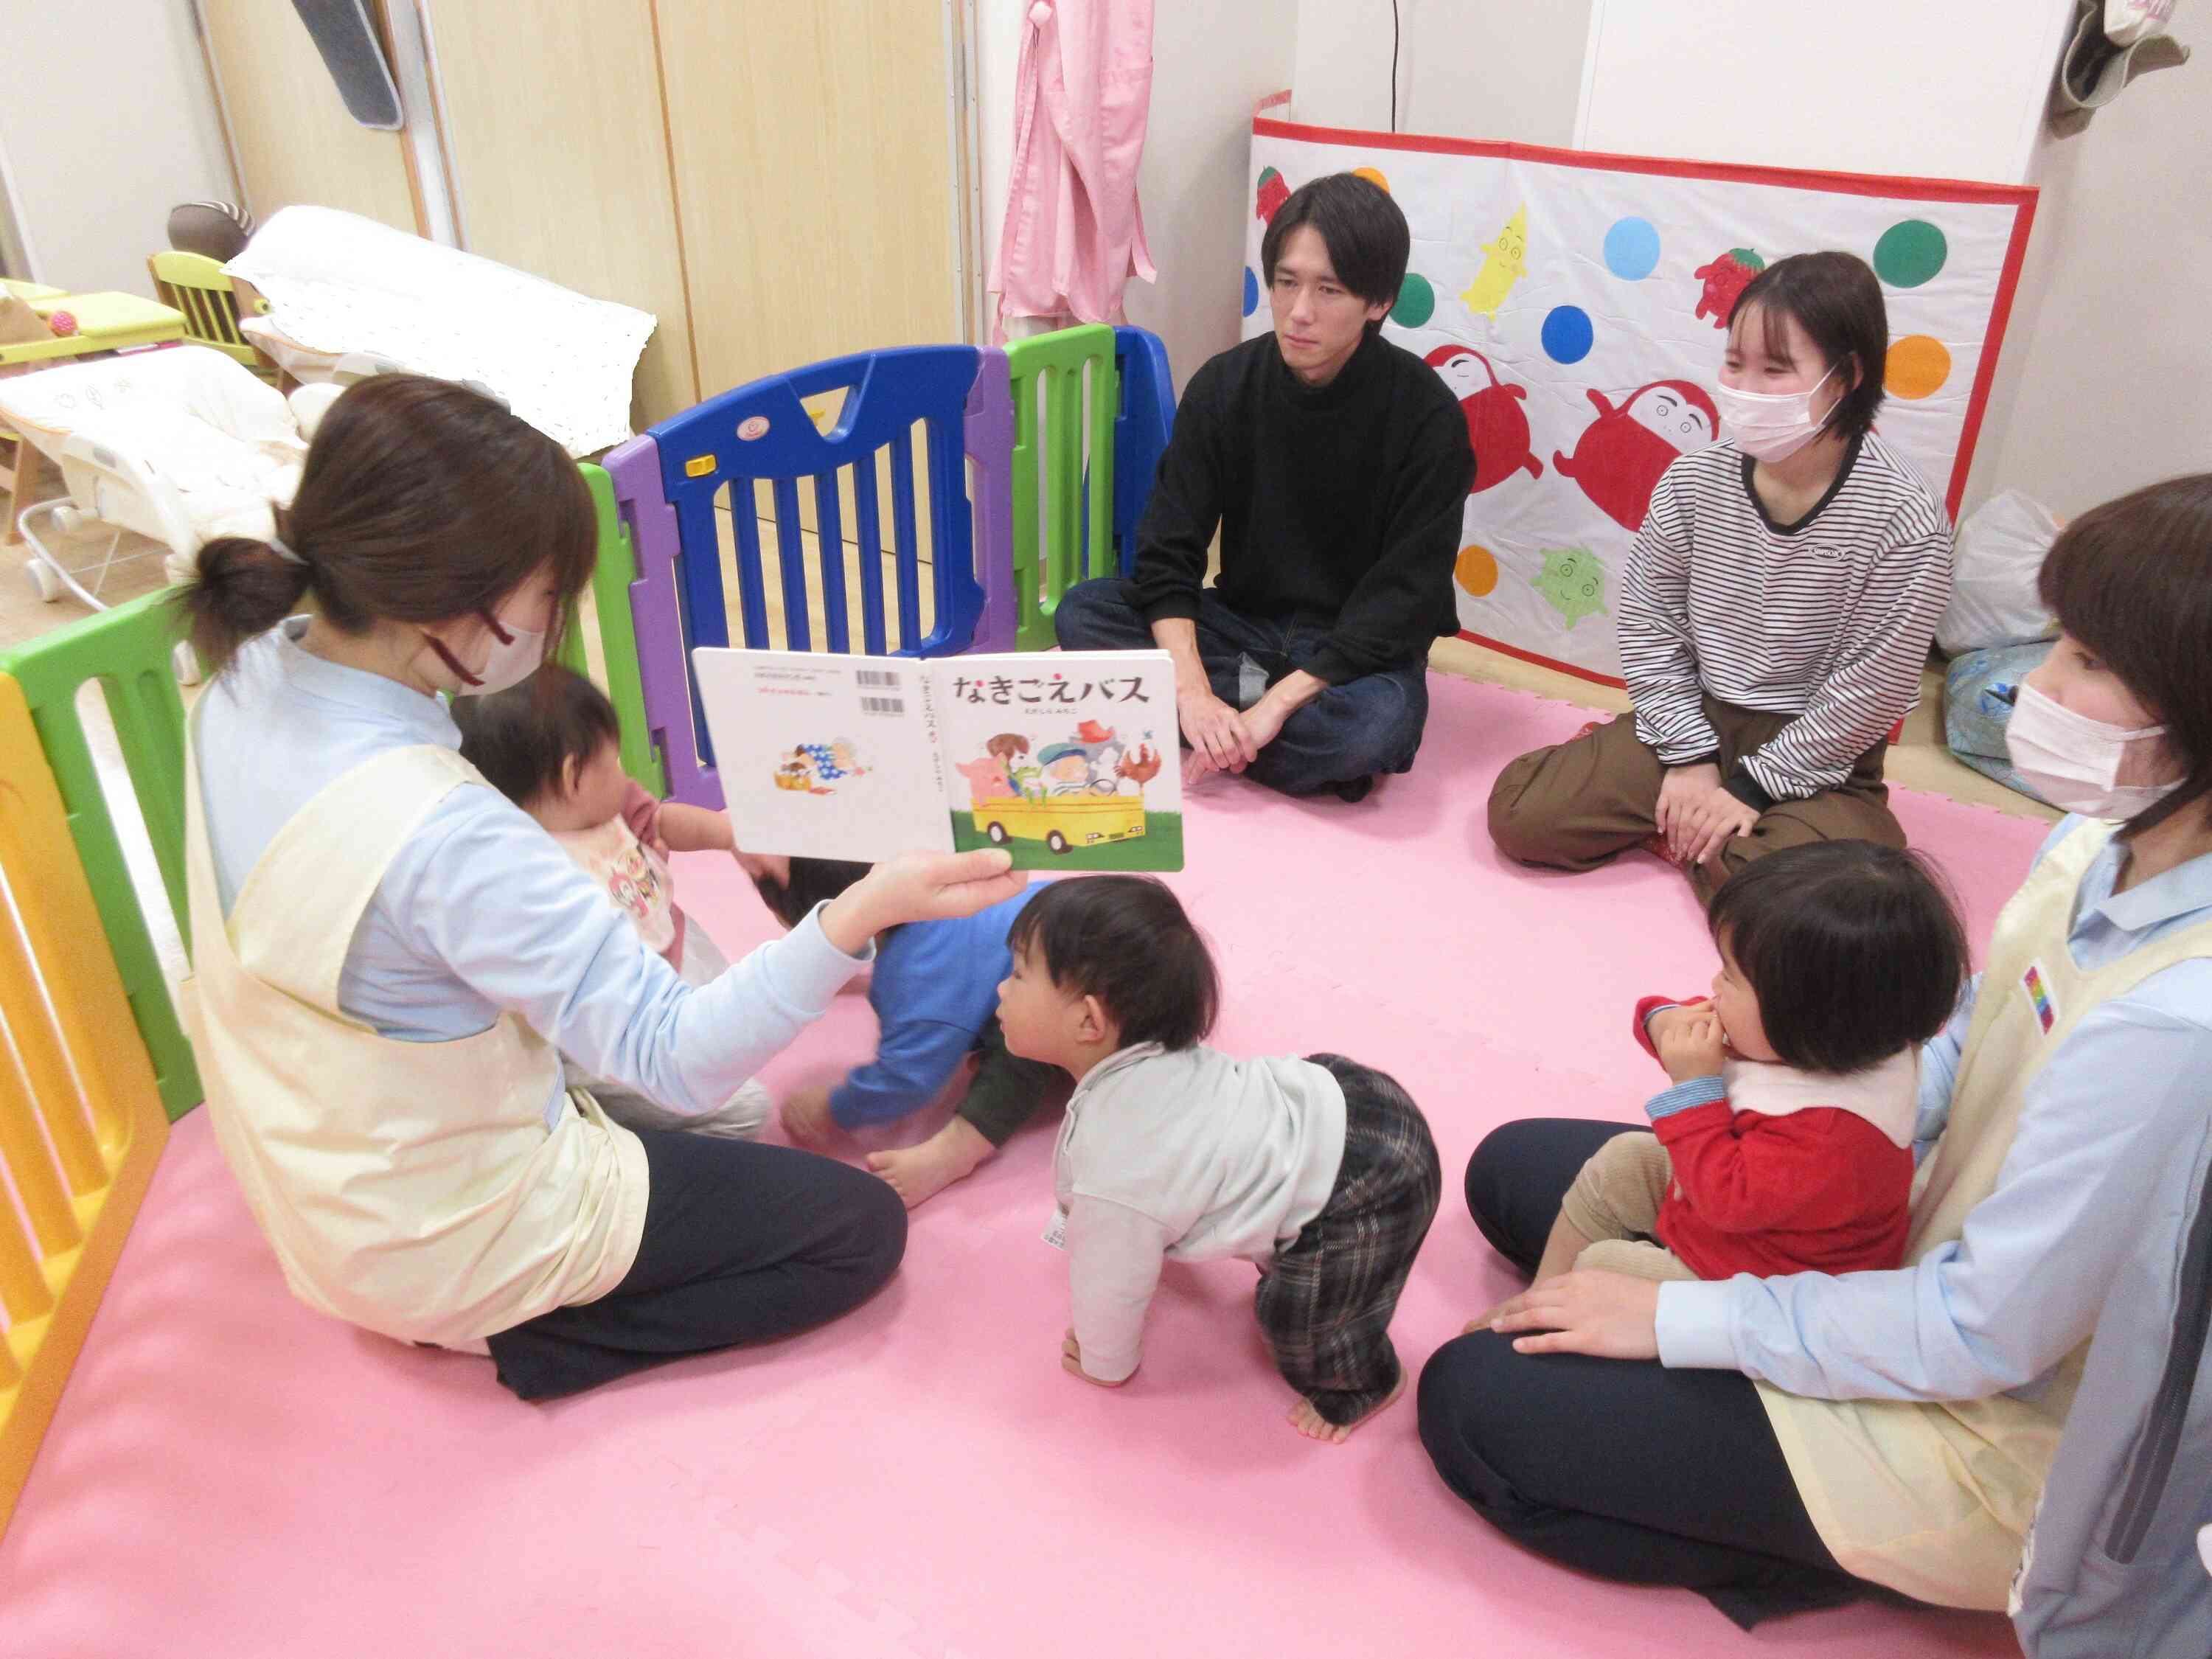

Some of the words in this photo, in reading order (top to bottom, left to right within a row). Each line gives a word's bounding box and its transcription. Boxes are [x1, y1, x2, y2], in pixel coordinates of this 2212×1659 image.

[953, 673, 1150, 705] なきごえバス
